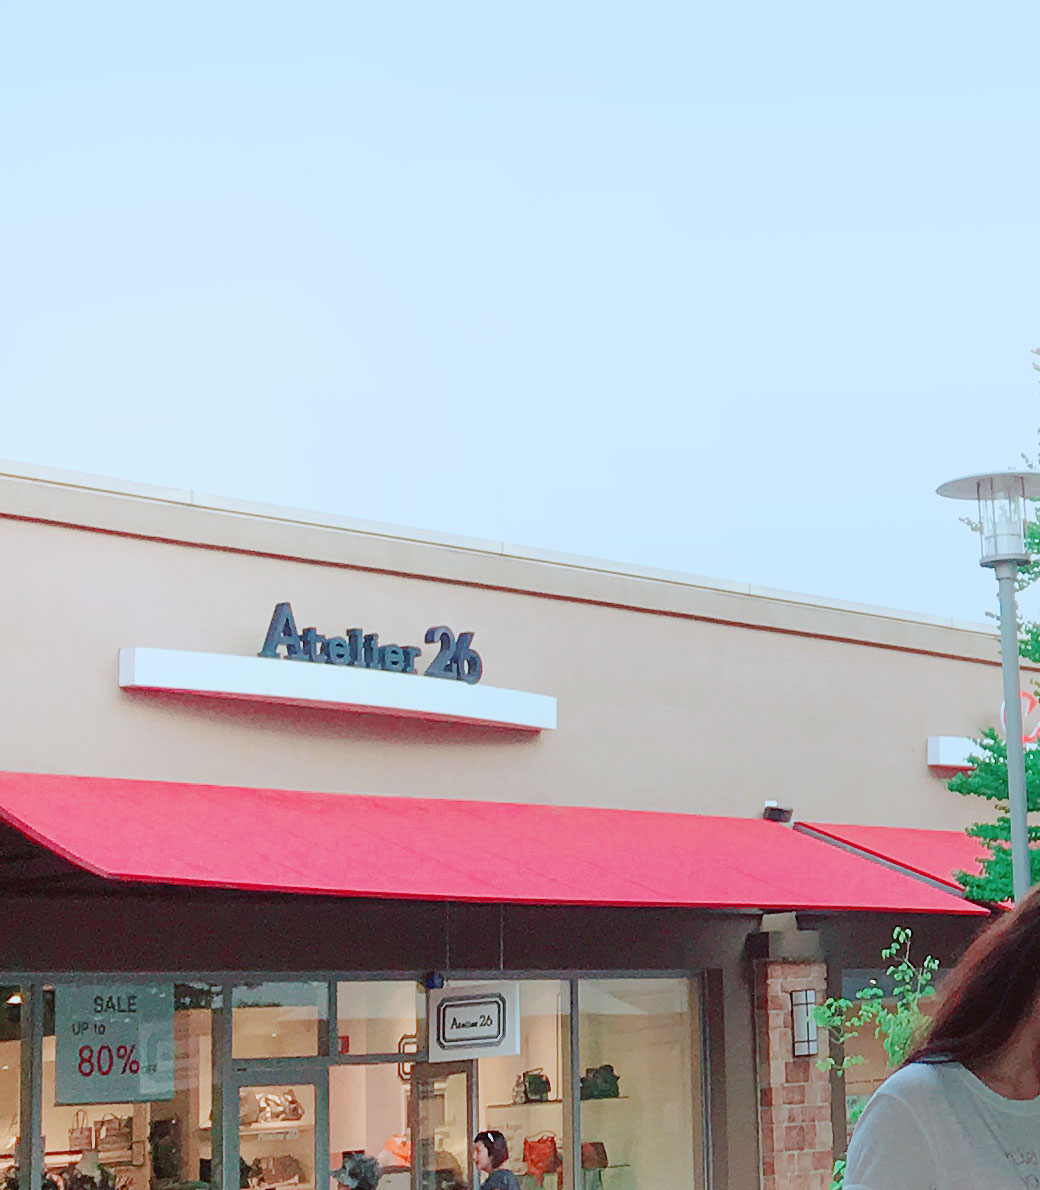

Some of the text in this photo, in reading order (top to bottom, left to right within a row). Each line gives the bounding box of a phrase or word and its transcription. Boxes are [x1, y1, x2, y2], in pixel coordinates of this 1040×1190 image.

[257, 602, 483, 685] Atelier 26
[93, 995, 137, 1014] SALE
[72, 1021, 89, 1036] UP
[78, 1044, 140, 1078] 80%
